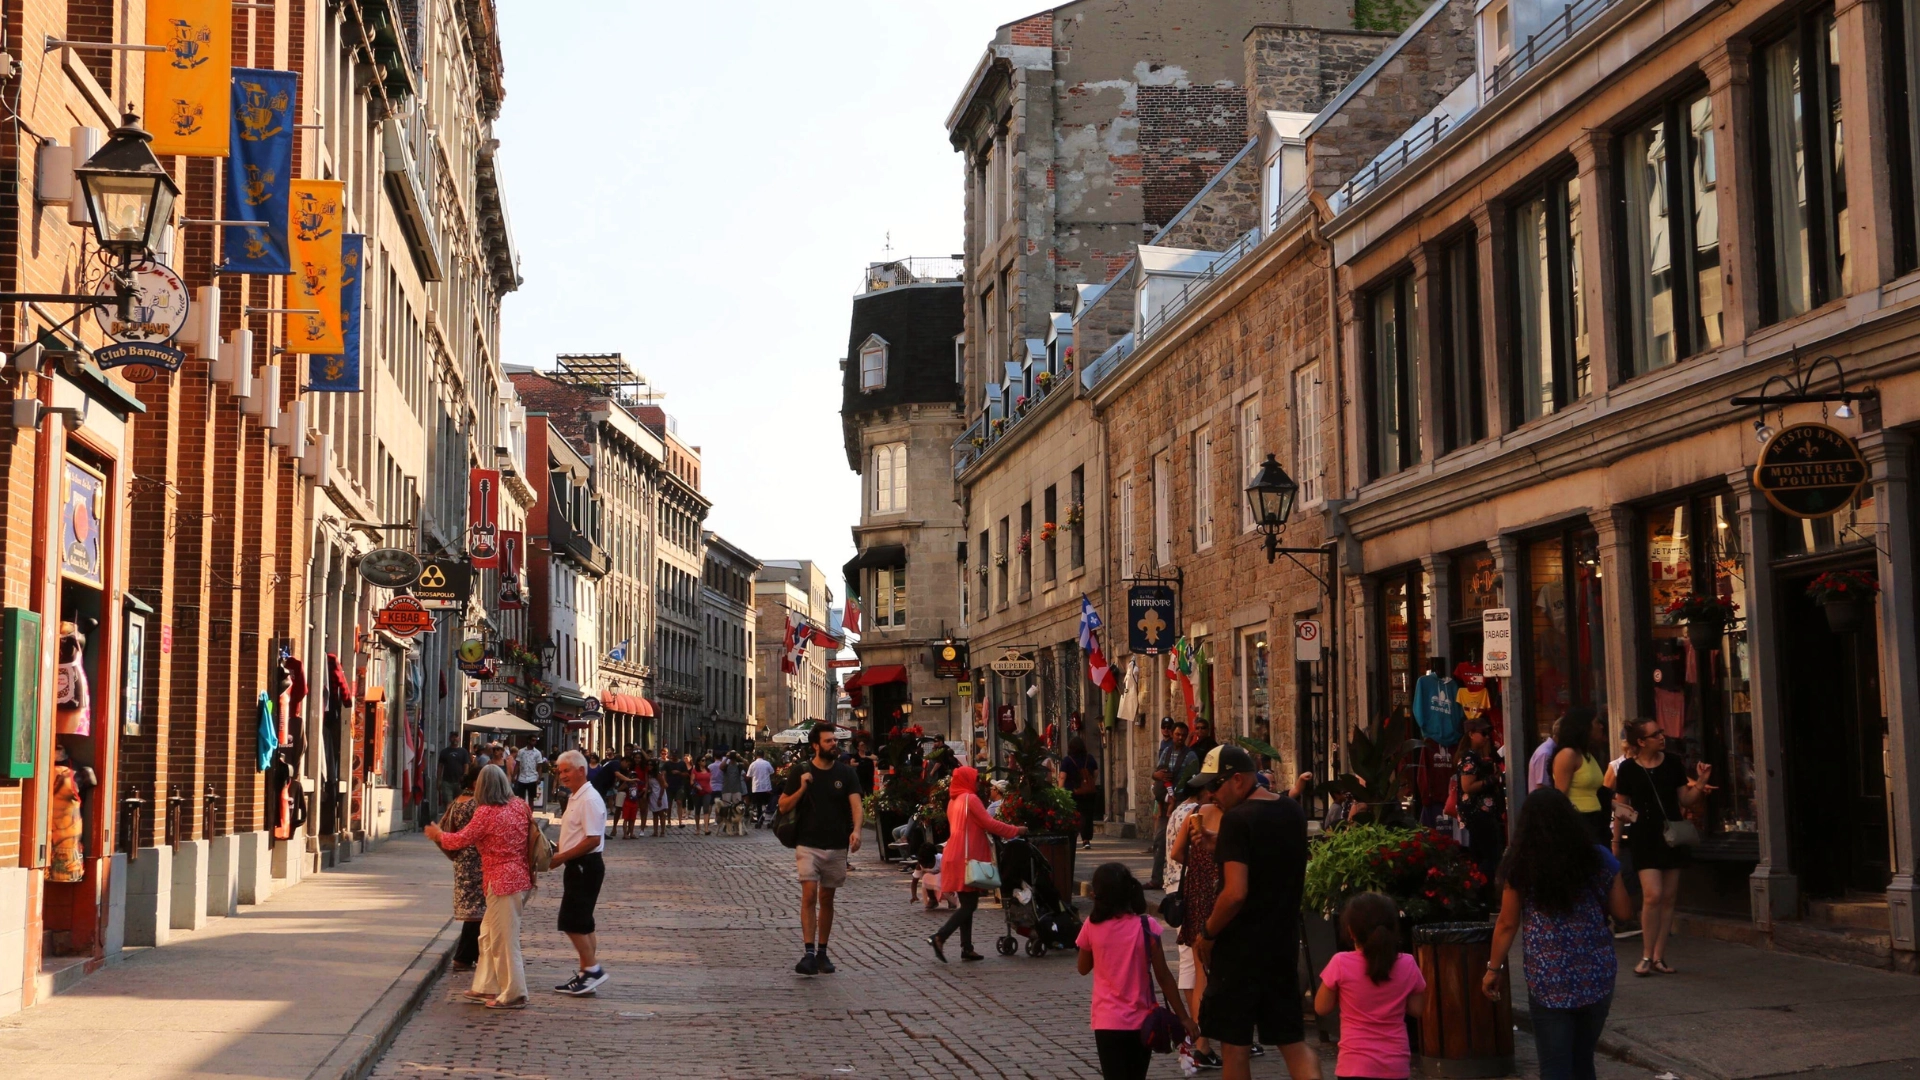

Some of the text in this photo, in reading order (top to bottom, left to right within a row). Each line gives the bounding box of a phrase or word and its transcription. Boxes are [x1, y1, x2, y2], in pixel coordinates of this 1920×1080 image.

[100, 346, 178, 364] Club Bavarois
[127, 368, 151, 378] 140
[1772, 428, 1844, 455] RESTO BAR
[1770, 463, 1854, 477] MONTREAL
[1780, 473, 1846, 486] POUTINE
[388, 598, 420, 610] MONTREAL
[1131, 599, 1171, 607] PATRIOTE
[388, 612, 420, 623] KEBAB
[1484, 629, 1509, 639] TABAGIE
[1484, 663, 1509, 671] CUBAINS
[959, 685, 971, 693] ATM
